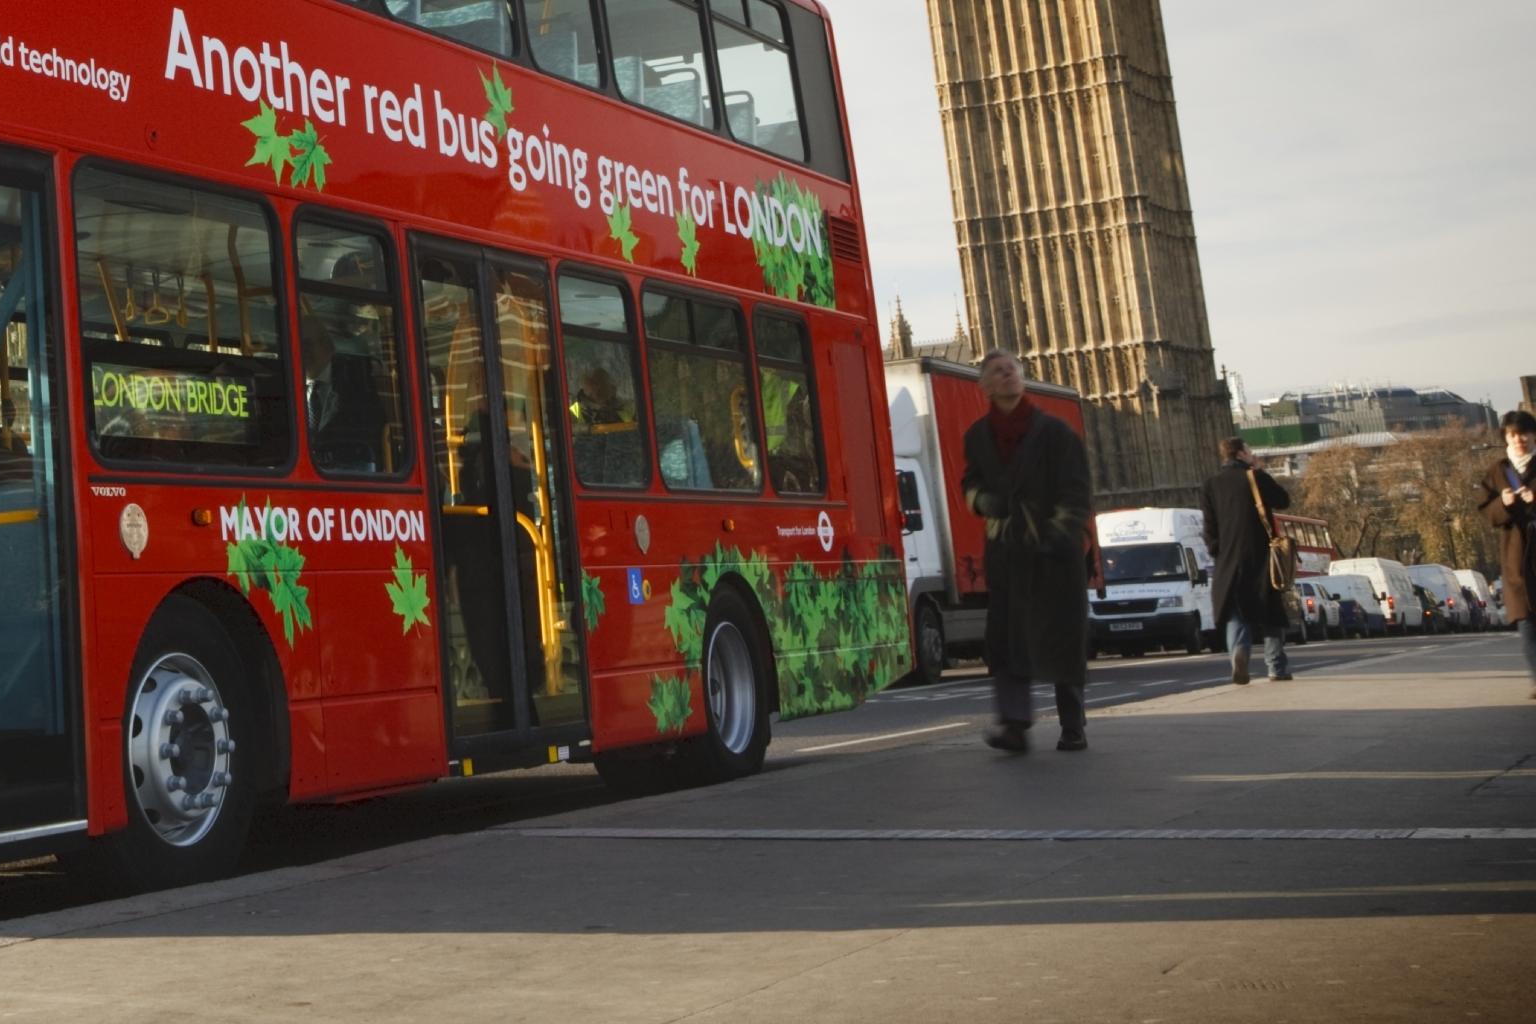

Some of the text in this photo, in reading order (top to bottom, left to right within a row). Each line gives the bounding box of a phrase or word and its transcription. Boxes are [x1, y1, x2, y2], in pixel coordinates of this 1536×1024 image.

[18, 40, 131, 102] technology
[164, 7, 824, 258] Another red bus going green for LONDON
[92, 371, 249, 417] LONDON BRIDGE
[90, 486, 127, 497] VOLVO
[219, 505, 425, 542] MAYOR OF LONDON
